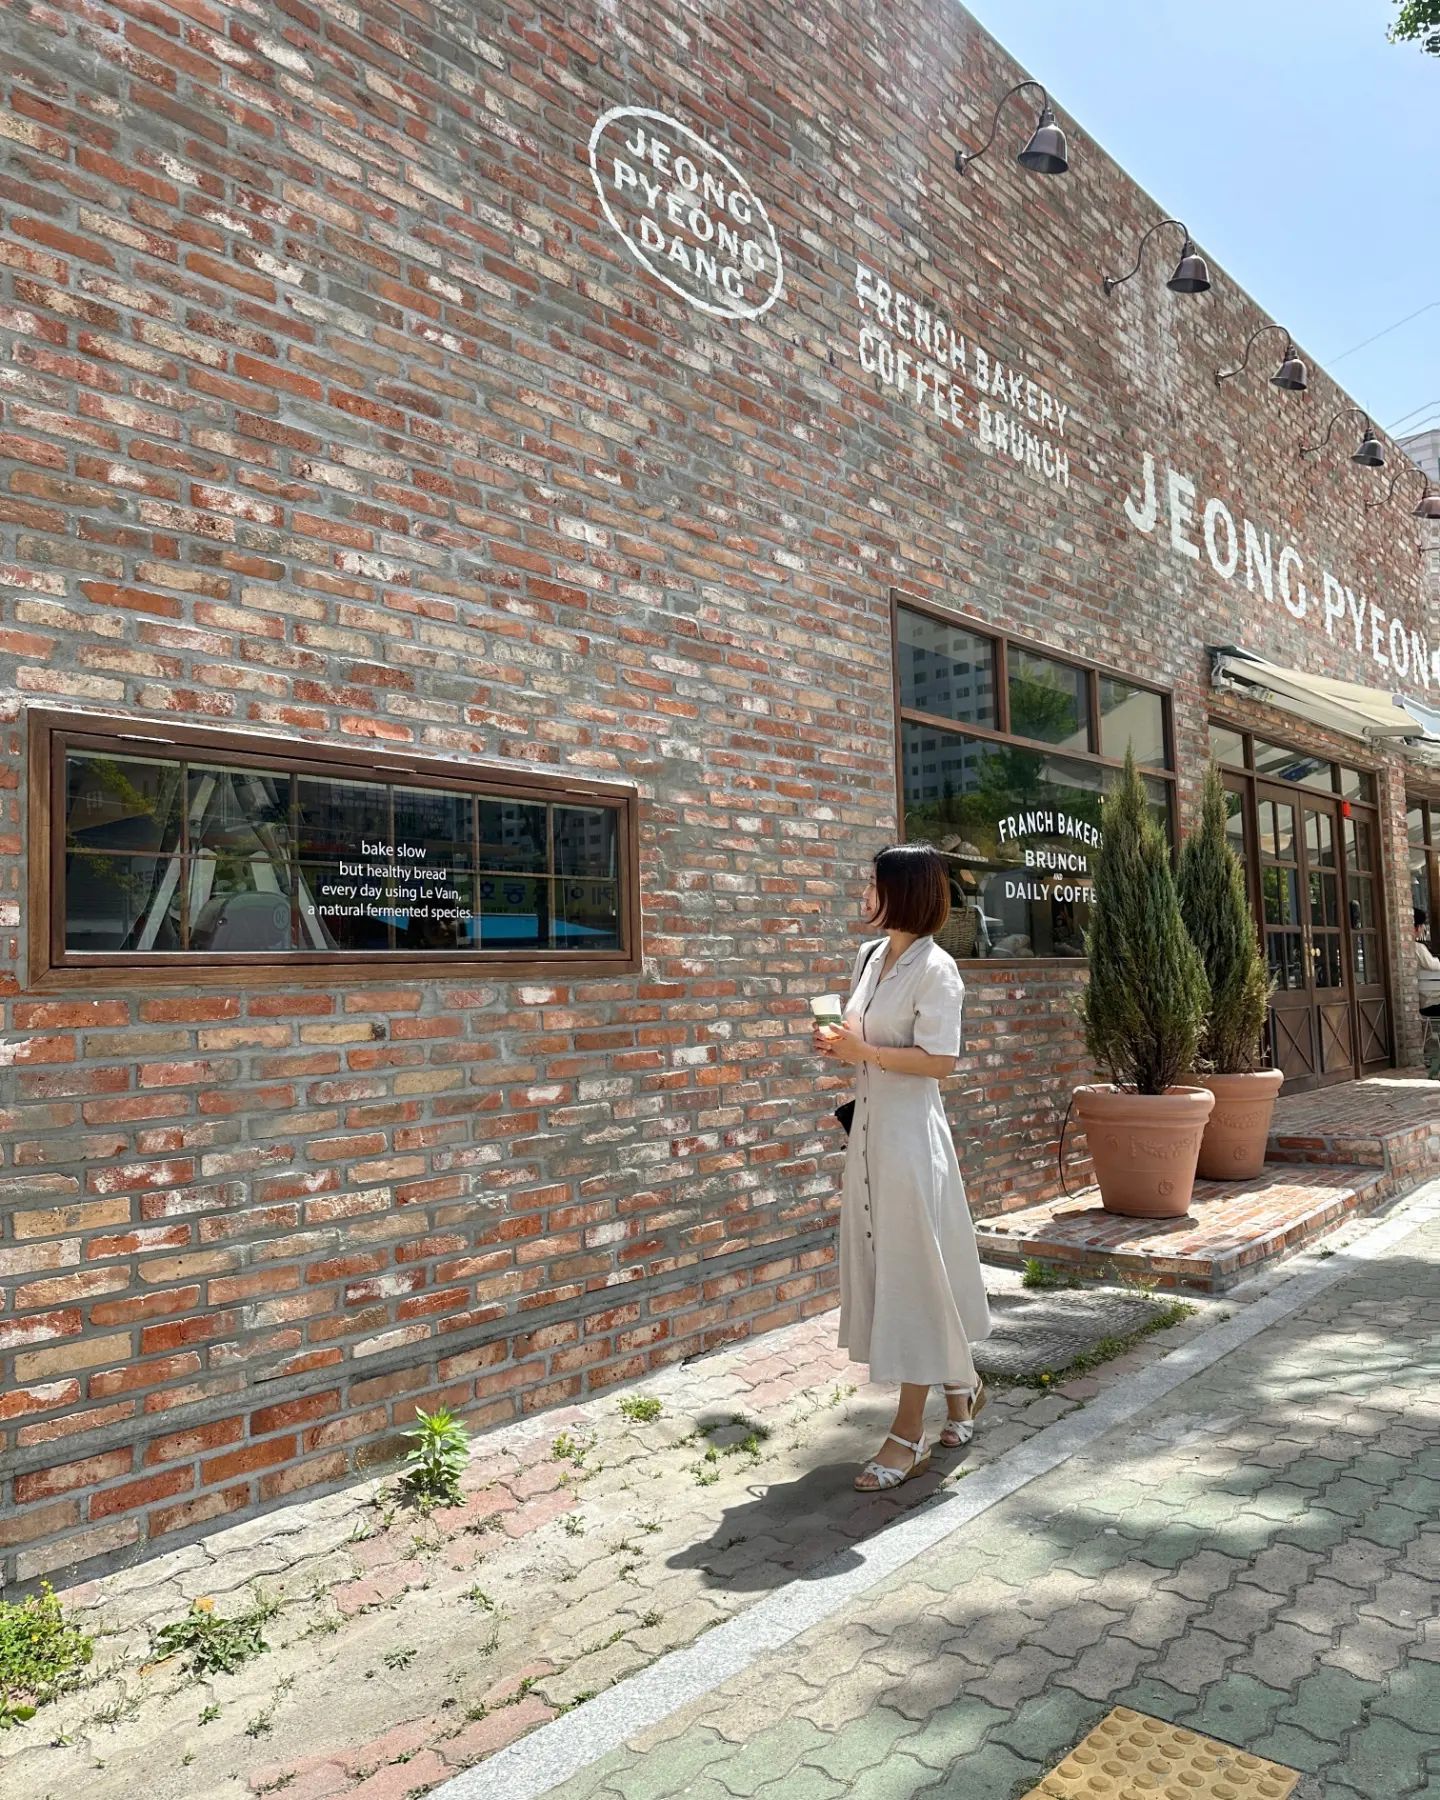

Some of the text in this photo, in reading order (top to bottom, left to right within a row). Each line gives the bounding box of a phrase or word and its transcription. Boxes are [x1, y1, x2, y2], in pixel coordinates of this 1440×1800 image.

[626, 128, 750, 225] JEONG
[613, 158, 765, 272] PYEONG
[640, 215, 744, 298] DANG
[856, 264, 1067, 437] FRENCH BAKERY
[859, 327, 1069, 488] COFFEE BRUNCH
[1123, 451, 1440, 690] JEONG PYEON
[998, 811, 1054, 843] FRANCH
[361, 840, 426, 858] bake slow
[1025, 850, 1087, 872] BRUNCH
[339, 861, 447, 881] but healthy bread
[1053, 873, 1063, 881] AND
[322, 885, 357, 899] every
[360, 884, 382, 900] day
[385, 886, 417, 901] using
[420, 887, 433, 899] Le
[1005, 881, 1097, 903] DAILY COFFE
[307, 903, 473, 920] a natural fermented species.
